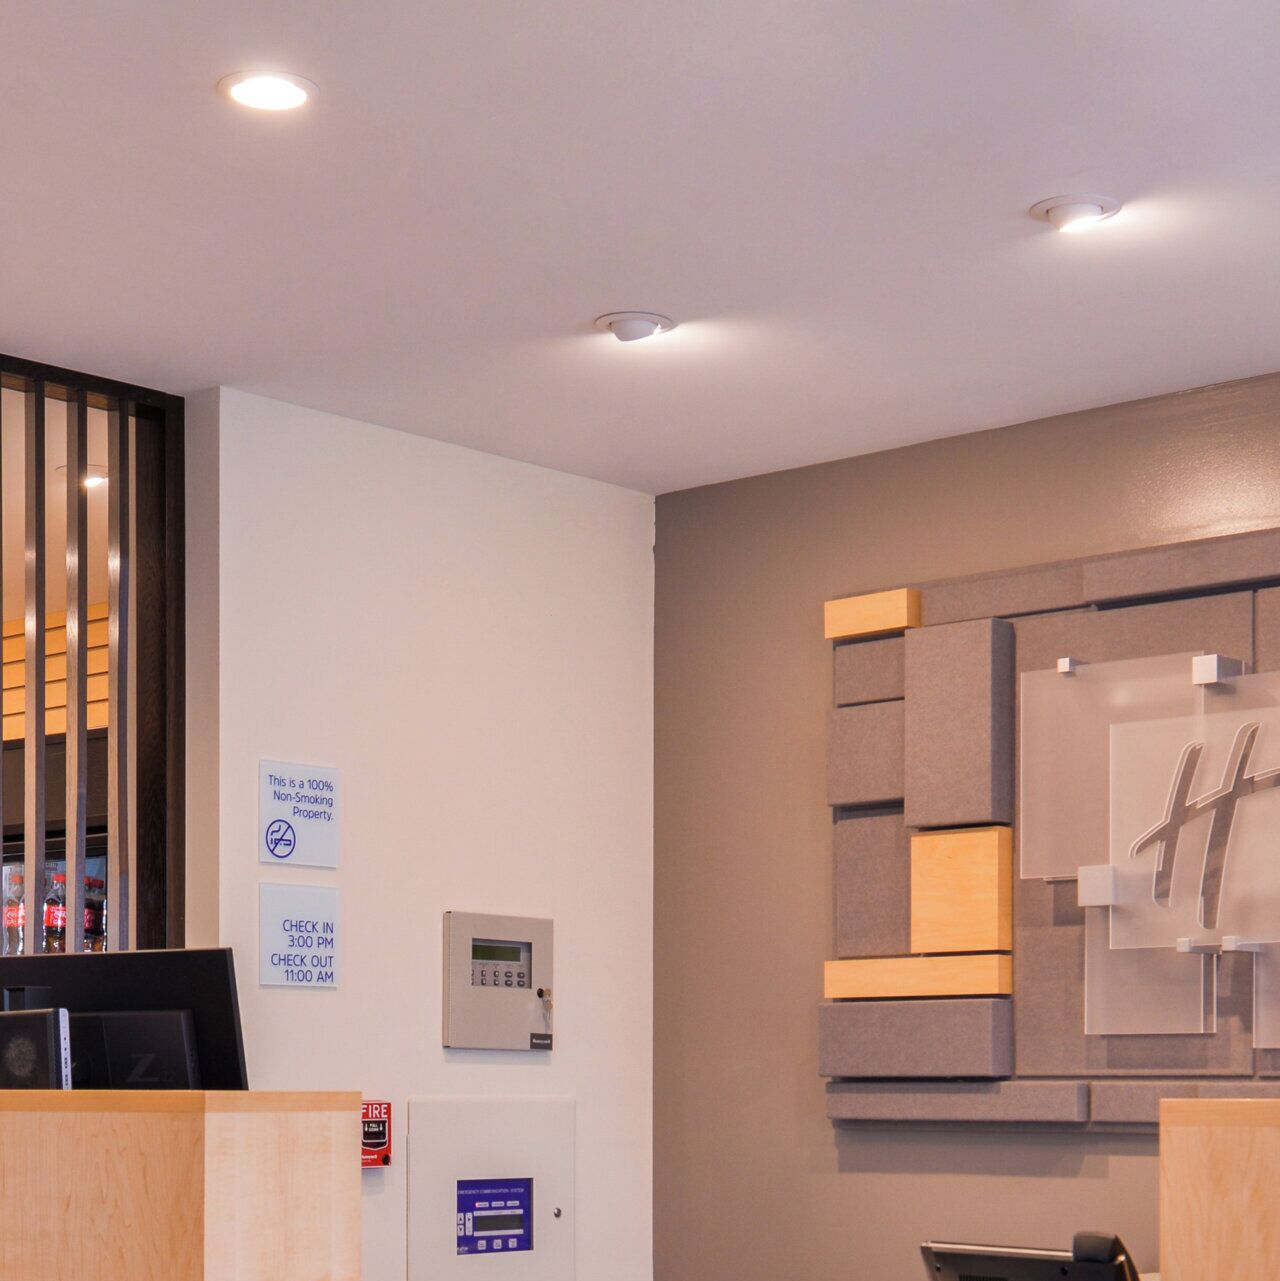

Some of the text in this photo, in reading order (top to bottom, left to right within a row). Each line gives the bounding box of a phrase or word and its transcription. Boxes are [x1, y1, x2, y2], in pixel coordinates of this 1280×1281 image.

[268, 774, 334, 792] This is a 100%
[273, 789, 334, 807] Non-Smoking
[292, 805, 334, 821] Property.
[282, 919, 334, 934] CHECK IN
[288, 934, 334, 949] 3:00 PM
[270, 953, 334, 968] CHECK OUT
[284, 969, 334, 983] 11:00 AM
